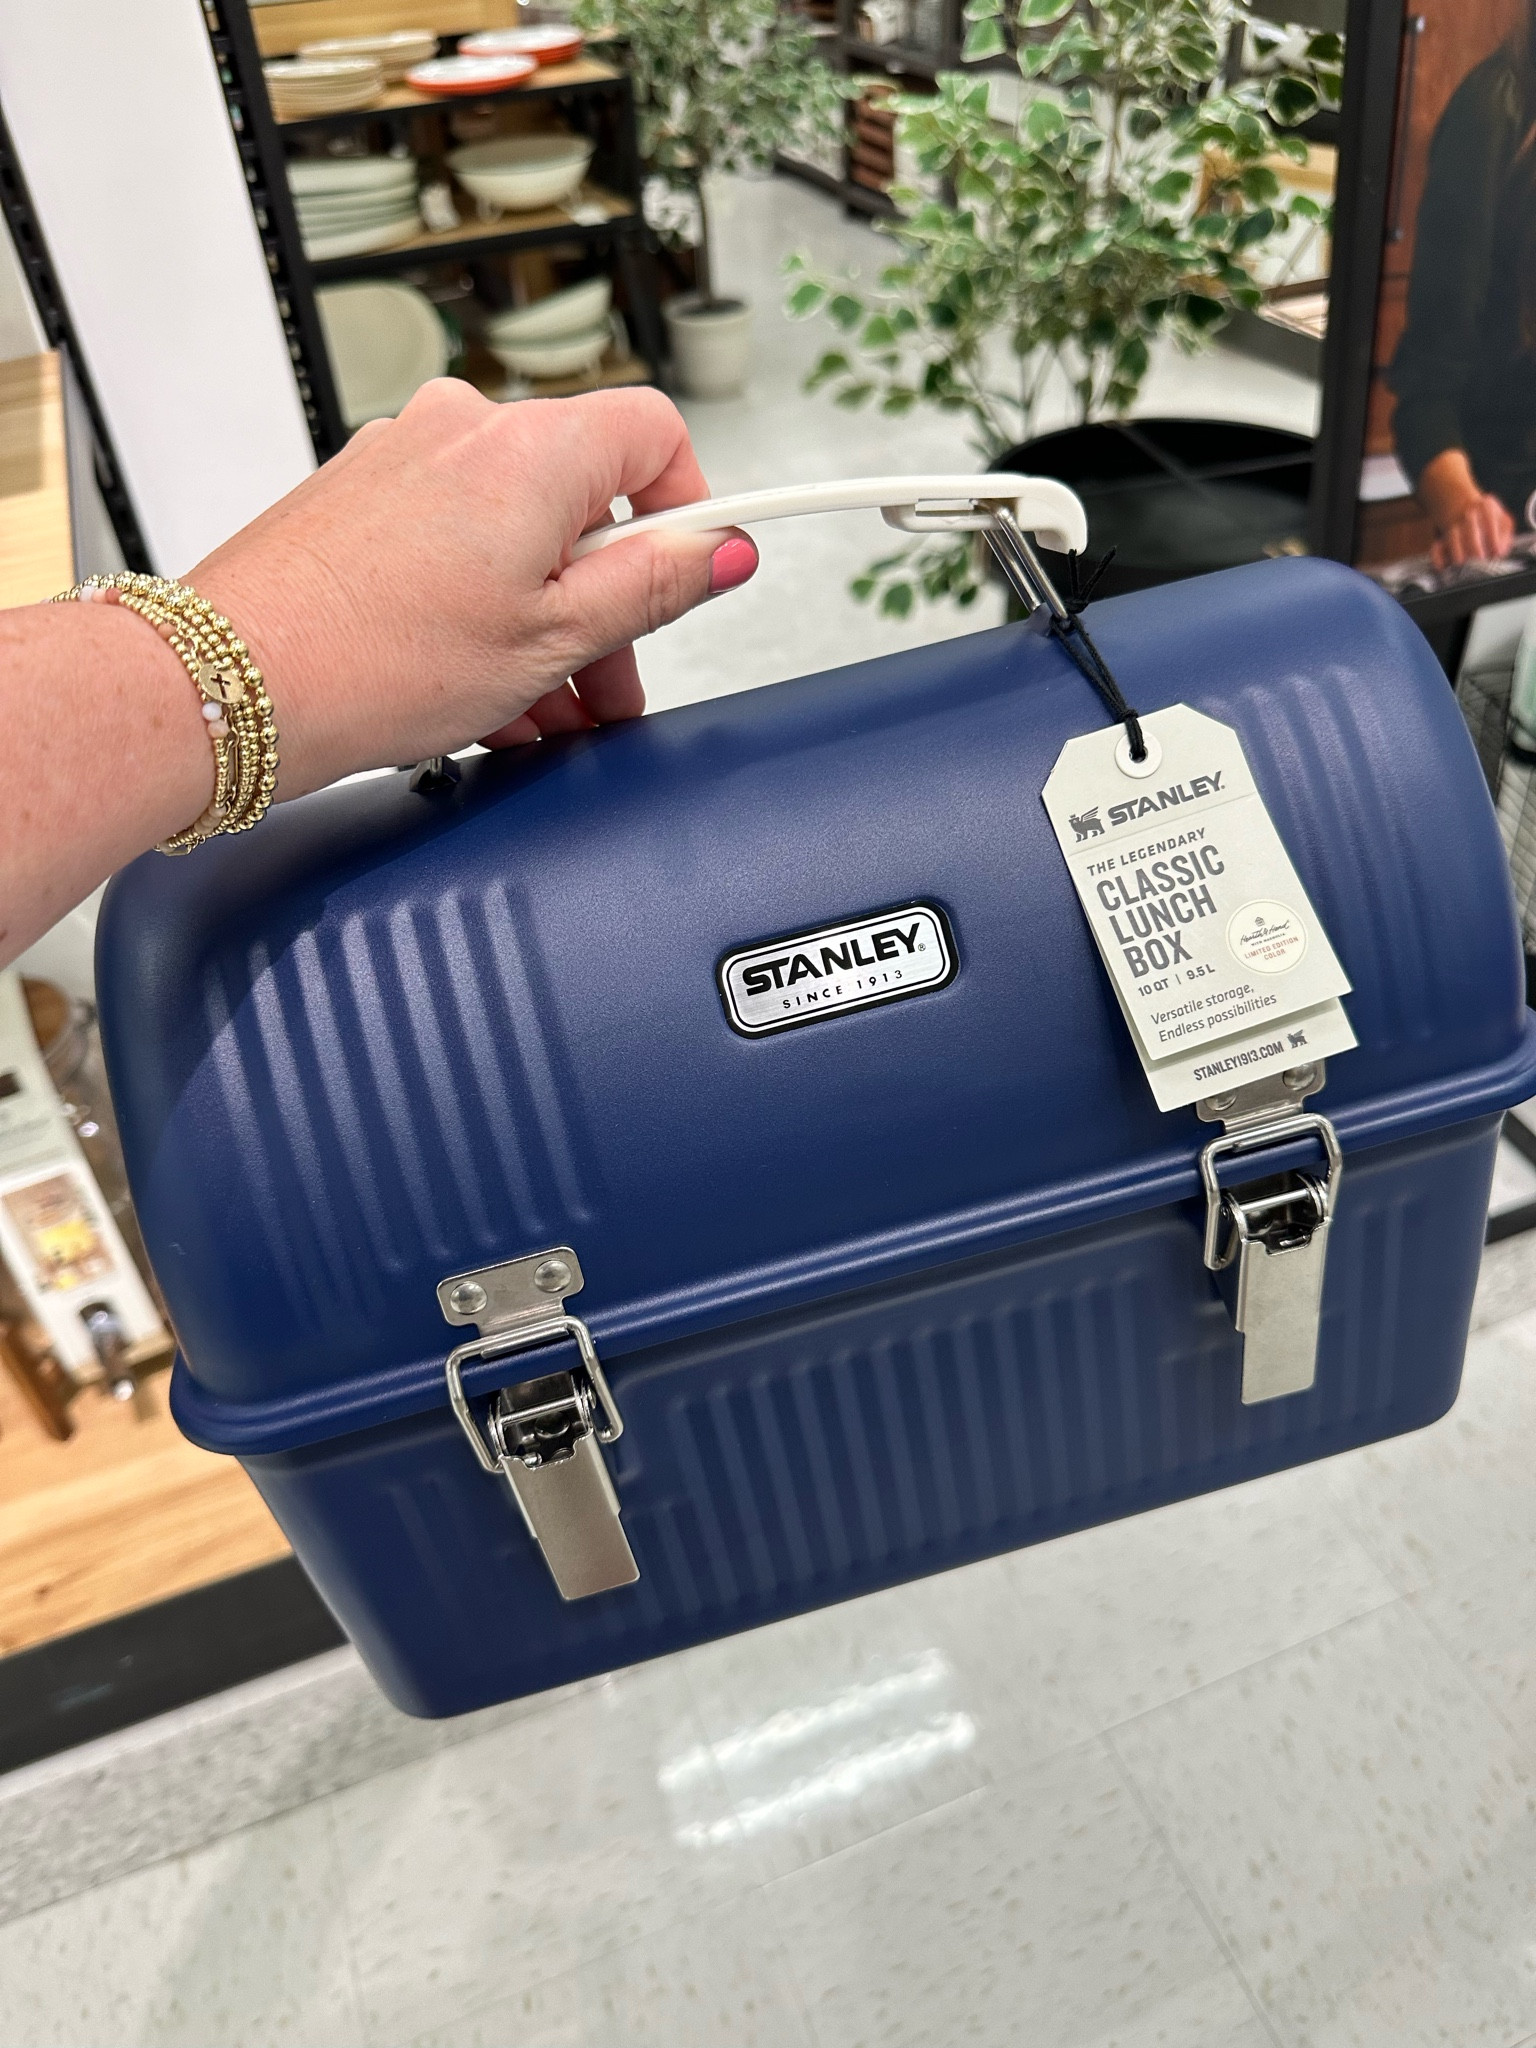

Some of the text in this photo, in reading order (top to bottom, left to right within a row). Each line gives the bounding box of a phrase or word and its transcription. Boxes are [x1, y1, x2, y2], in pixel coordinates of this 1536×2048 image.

[1107, 770, 1224, 826] STANLEY
[1087, 827, 1205, 876] THE LEGENDARY
[1096, 844, 1225, 911] CLASSIC
[1108, 884, 1218, 945] LUNCH
[1122, 930, 1193, 978] BOX
[1244, 936, 1299, 960] LIMITED EDITION
[1264, 948, 1286, 961] COLOR
[782, 969, 904, 1009] SINCE 1913
[1138, 984, 1153, 997] 10
[1153, 978, 1170, 992] QT
[1186, 965, 1206, 980] 9.5
[1207, 963, 1216, 974] L
[1150, 983, 1255, 1025] Versatile storage,
[1158, 993, 1277, 1042] Endless possibilities
[1193, 1041, 1285, 1081] STANLEY1913.COM
